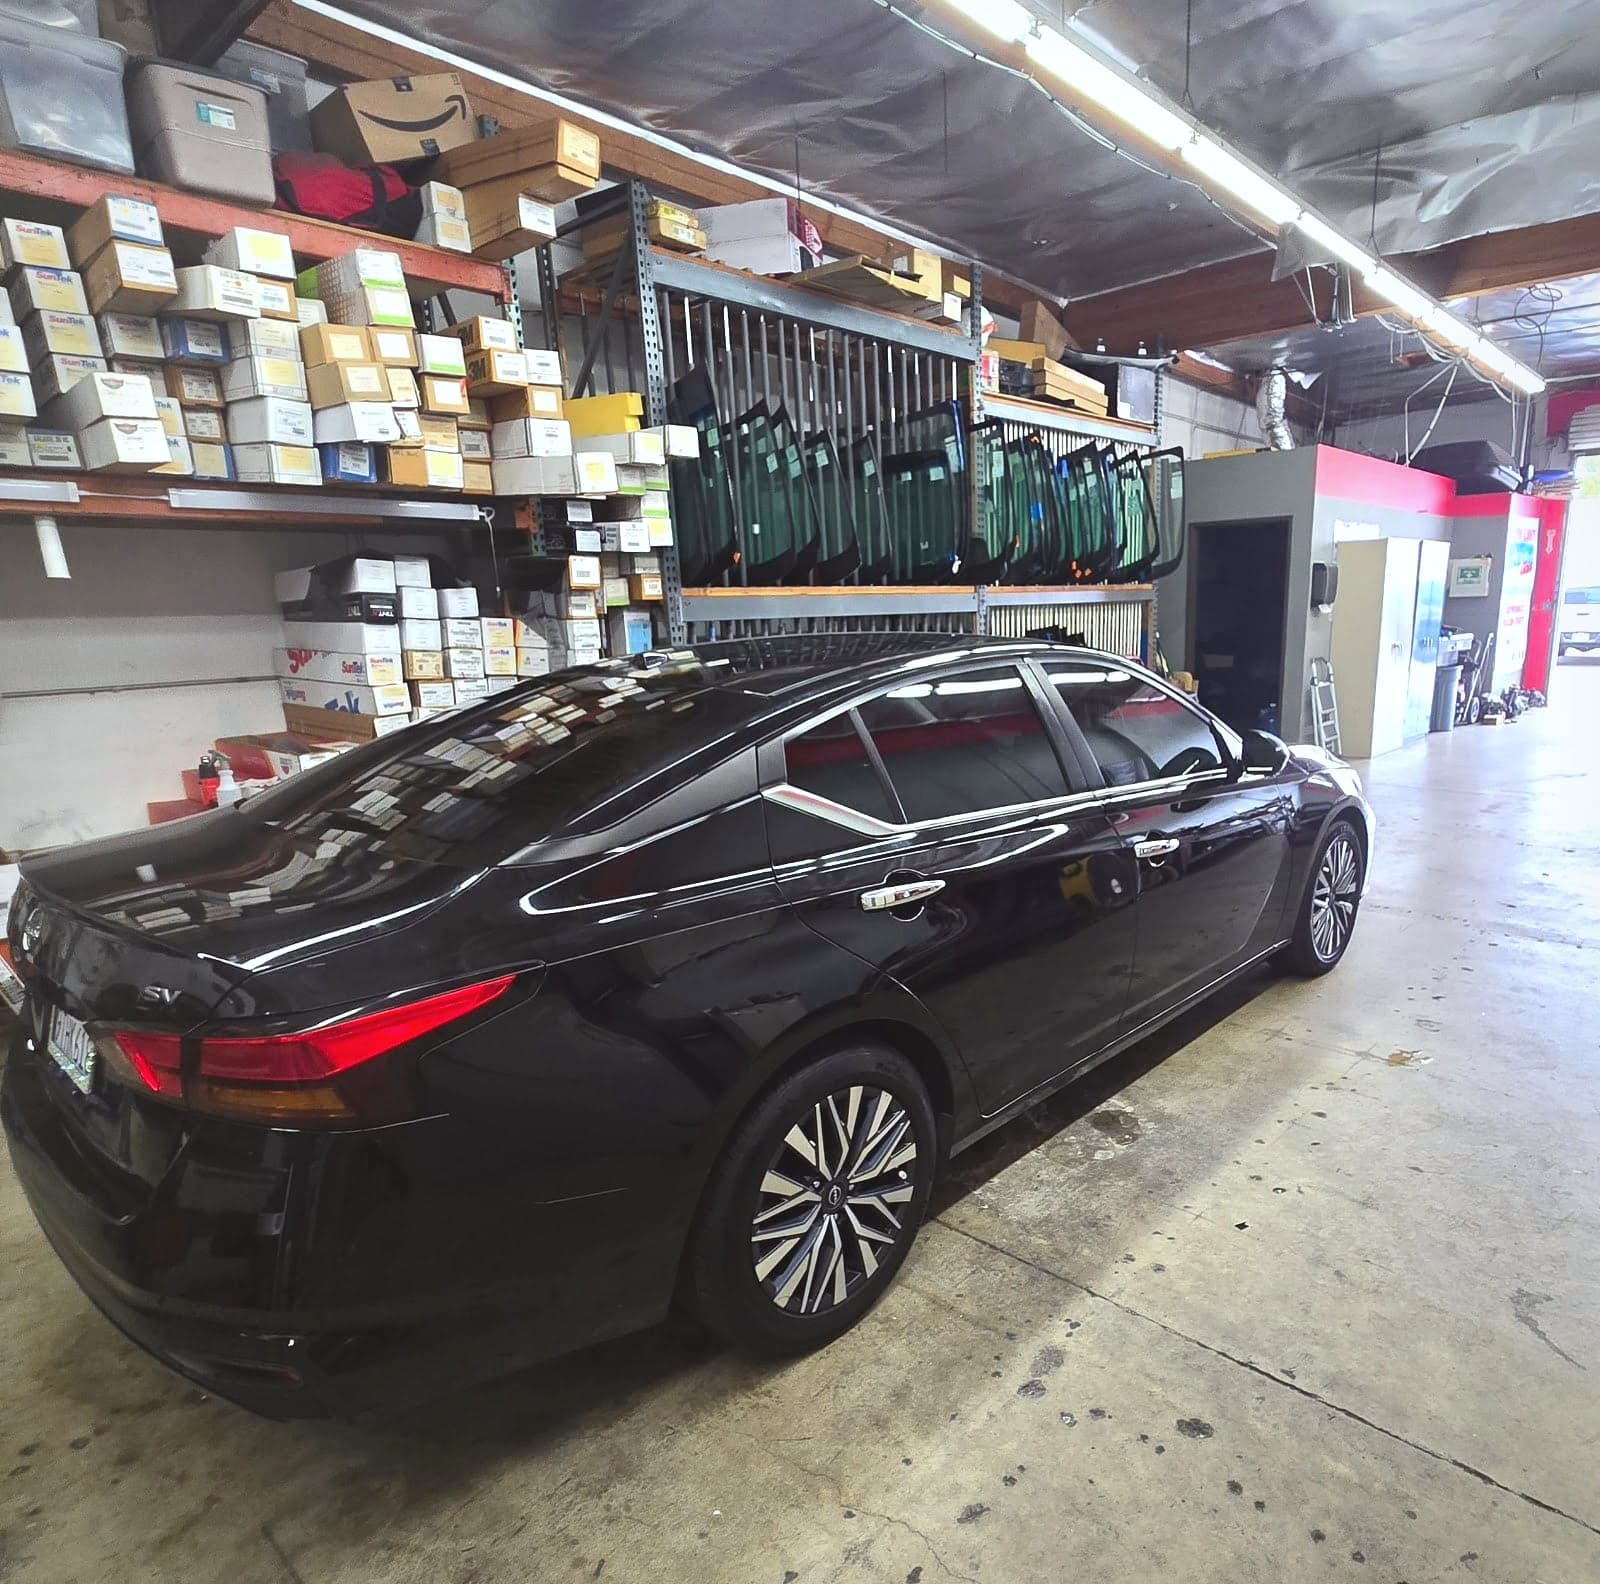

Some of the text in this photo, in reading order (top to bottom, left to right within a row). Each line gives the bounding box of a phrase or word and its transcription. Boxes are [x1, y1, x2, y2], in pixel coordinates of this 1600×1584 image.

[15, 224, 53, 236] SunTek
[35, 271, 74, 284] SunTek
[48, 315, 86, 326] SunTek
[60, 357, 98, 368] SunTek
[144, 985, 182, 1004] SV
